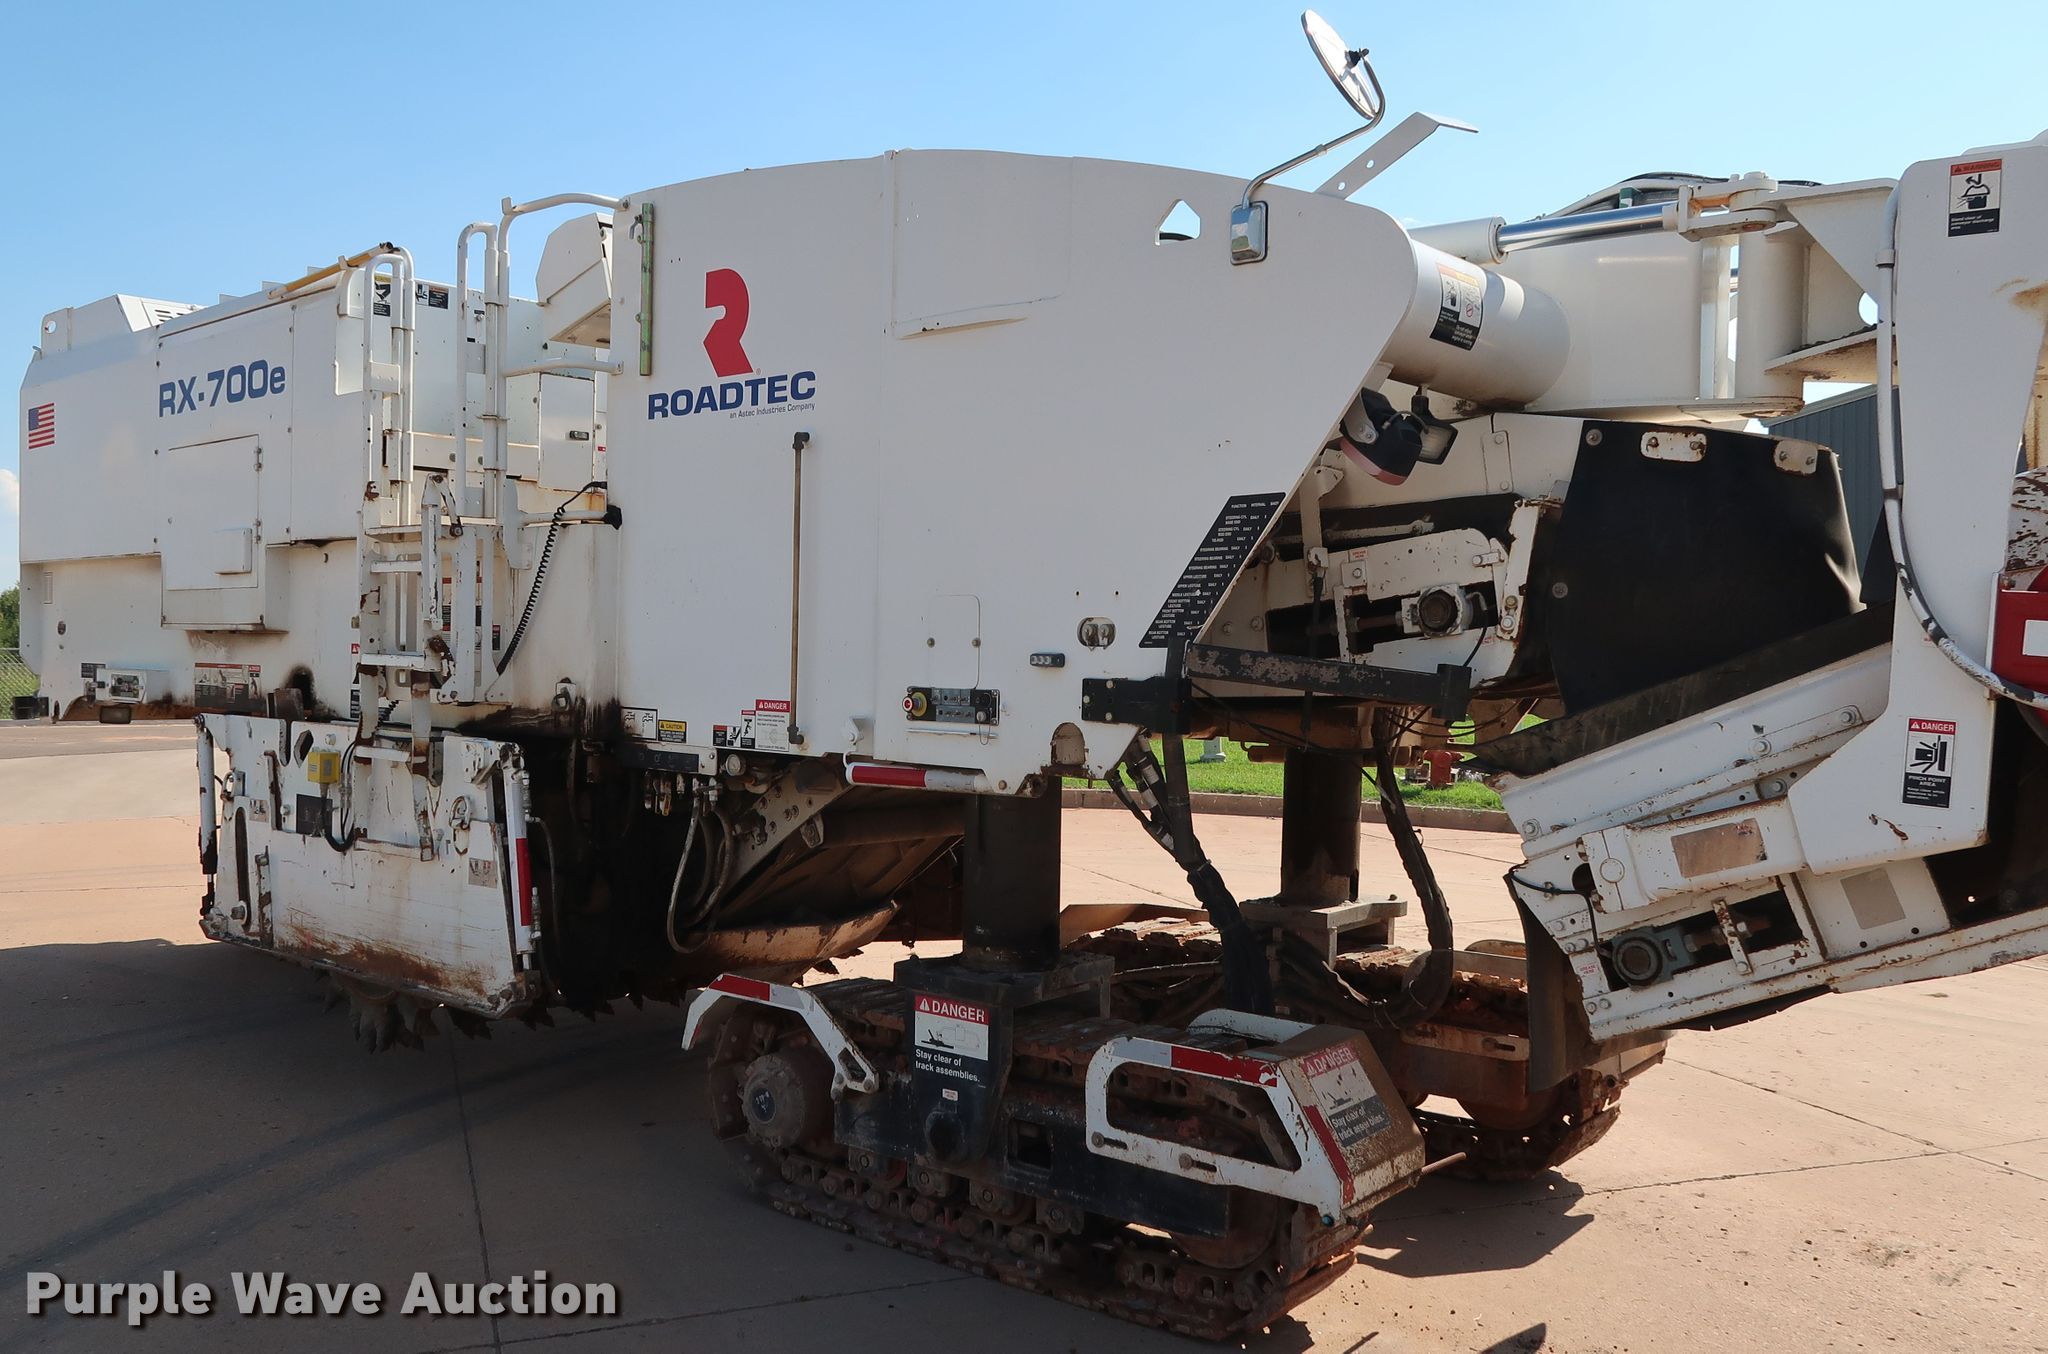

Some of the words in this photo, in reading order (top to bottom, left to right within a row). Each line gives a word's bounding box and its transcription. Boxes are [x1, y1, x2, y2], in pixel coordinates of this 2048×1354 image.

[159, 359, 286, 418] RX-700e
[648, 370, 816, 420] ROADTEC
[756, 406, 786, 415] Industries
[788, 403, 816, 412] Company
[764, 702, 787, 710] DANGER
[1921, 722, 1954, 732] DANGER
[932, 1000, 985, 1022] DANGER
[916, 1048, 932, 1061] Stay
[934, 1054, 952, 1064] clear
[954, 1058, 962, 1066] of
[1314, 1047, 1354, 1072] DANGER
[916, 1060, 934, 1072] track
[936, 1065, 980, 1082] assemblies.
